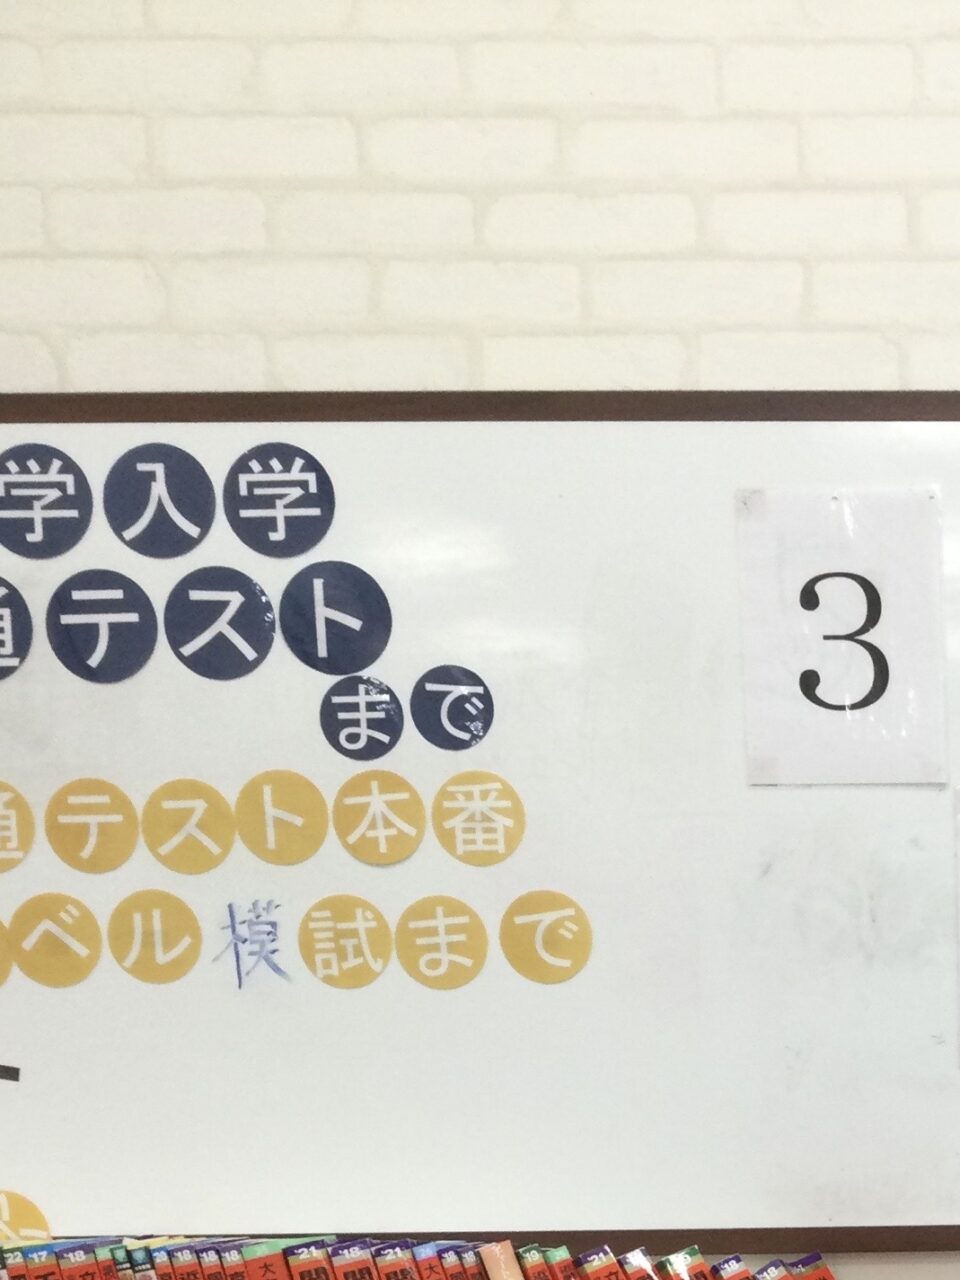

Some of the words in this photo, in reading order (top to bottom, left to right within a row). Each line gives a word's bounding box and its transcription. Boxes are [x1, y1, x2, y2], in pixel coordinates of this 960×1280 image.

[0, 457, 322, 543] 学入学
[0, 578, 362, 668] テスト
[331, 681, 484, 750] まで
[0, 900, 577, 990] ベル模試まで
